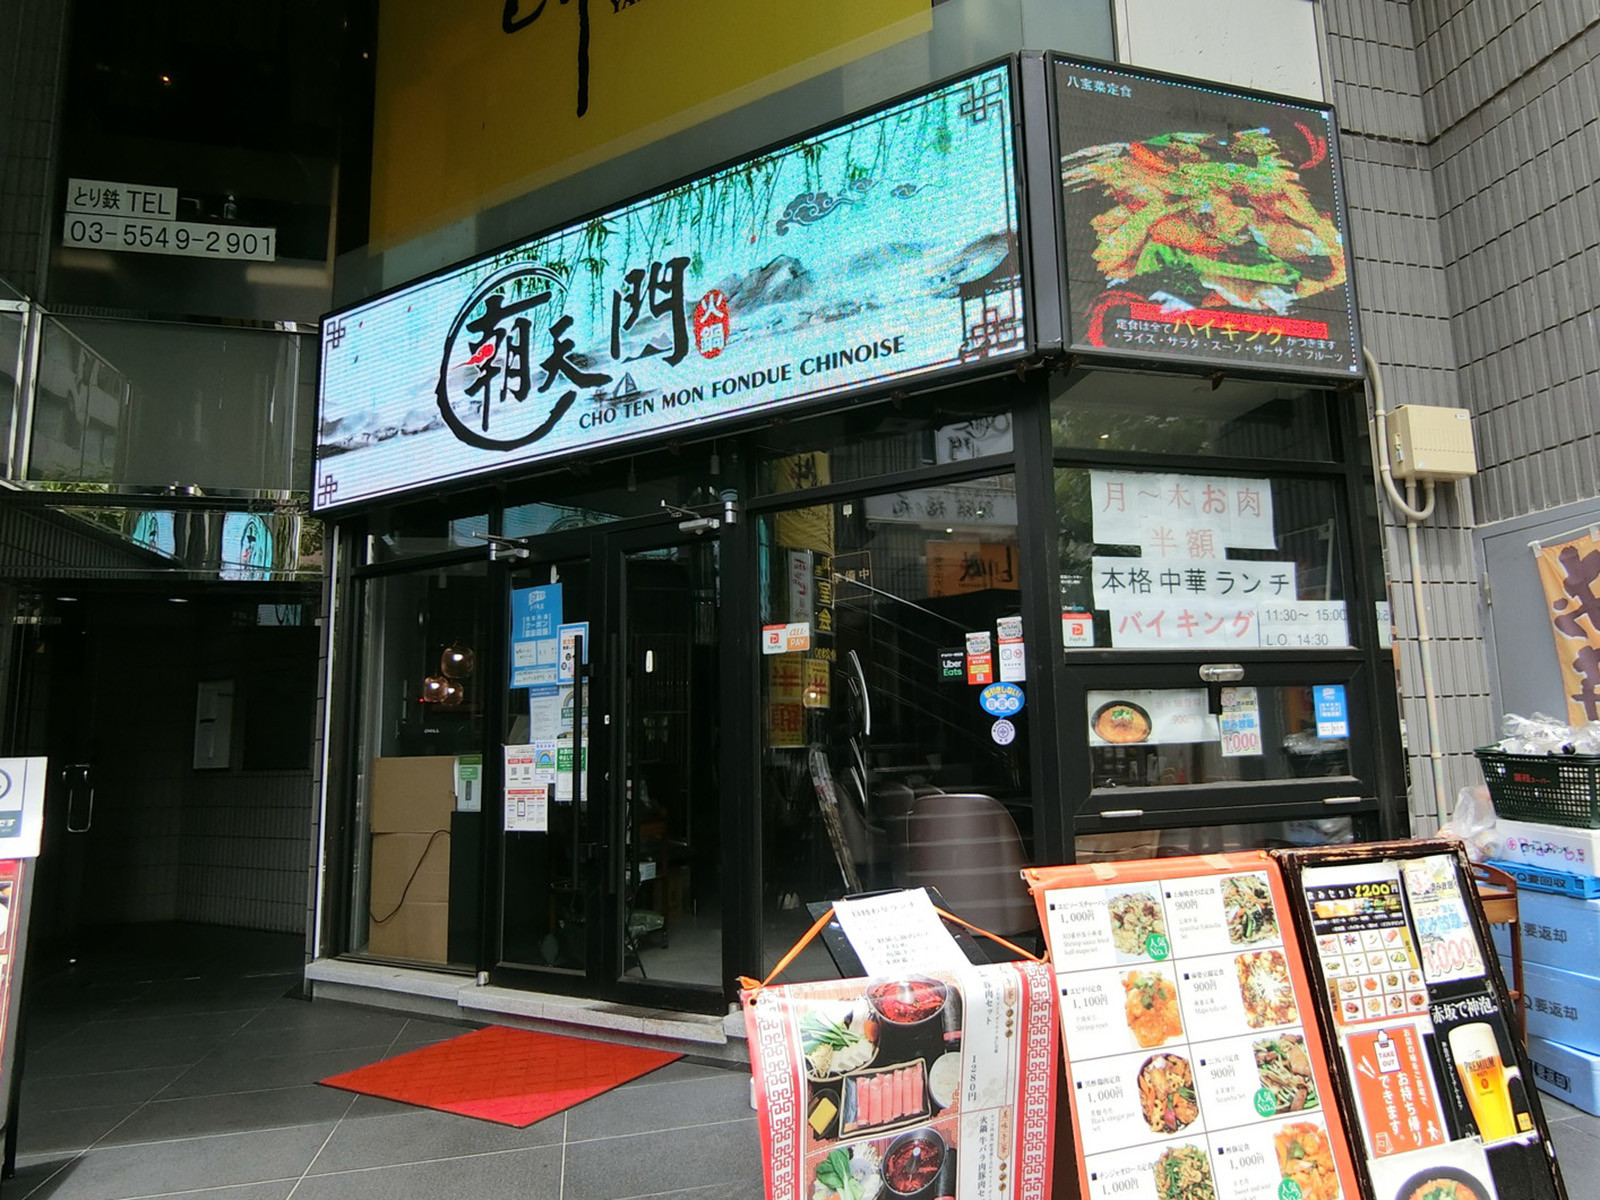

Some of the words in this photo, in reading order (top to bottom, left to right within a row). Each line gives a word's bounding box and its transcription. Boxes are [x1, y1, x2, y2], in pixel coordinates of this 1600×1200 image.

[74, 187, 120, 210] とり鉄
[126, 190, 171, 215] TEL
[70, 220, 271, 255] 03-5549-2901
[700, 291, 724, 350] 火鍋
[579, 407, 617, 429] CHO
[624, 398, 655, 420] TEN
[662, 385, 705, 410] MON
[712, 363, 792, 399] FONDUE
[800, 334, 905, 378] CHINOISE
[1150, 524, 1216, 559] 半額
[1101, 566, 1290, 594] 本格中華ランチ
[1118, 608, 1256, 638] バイキング
[791, 638, 805, 647] PAY
[1266, 633, 1292, 647] L.O.
[1298, 633, 1329, 647] 14:30
[942, 660, 962, 668] Uber
[943, 668, 962, 677] Eats
[1175, 899, 1198, 911] 900円
[1193, 979, 1217, 992] 900円
[1378, 1050, 1395, 1058] TAKE
[1382, 1059, 1395, 1067] OUT
[1464, 1056, 1495, 1073] PREMIUM
[1397, 1071, 1423, 1146] お持ち帰り
